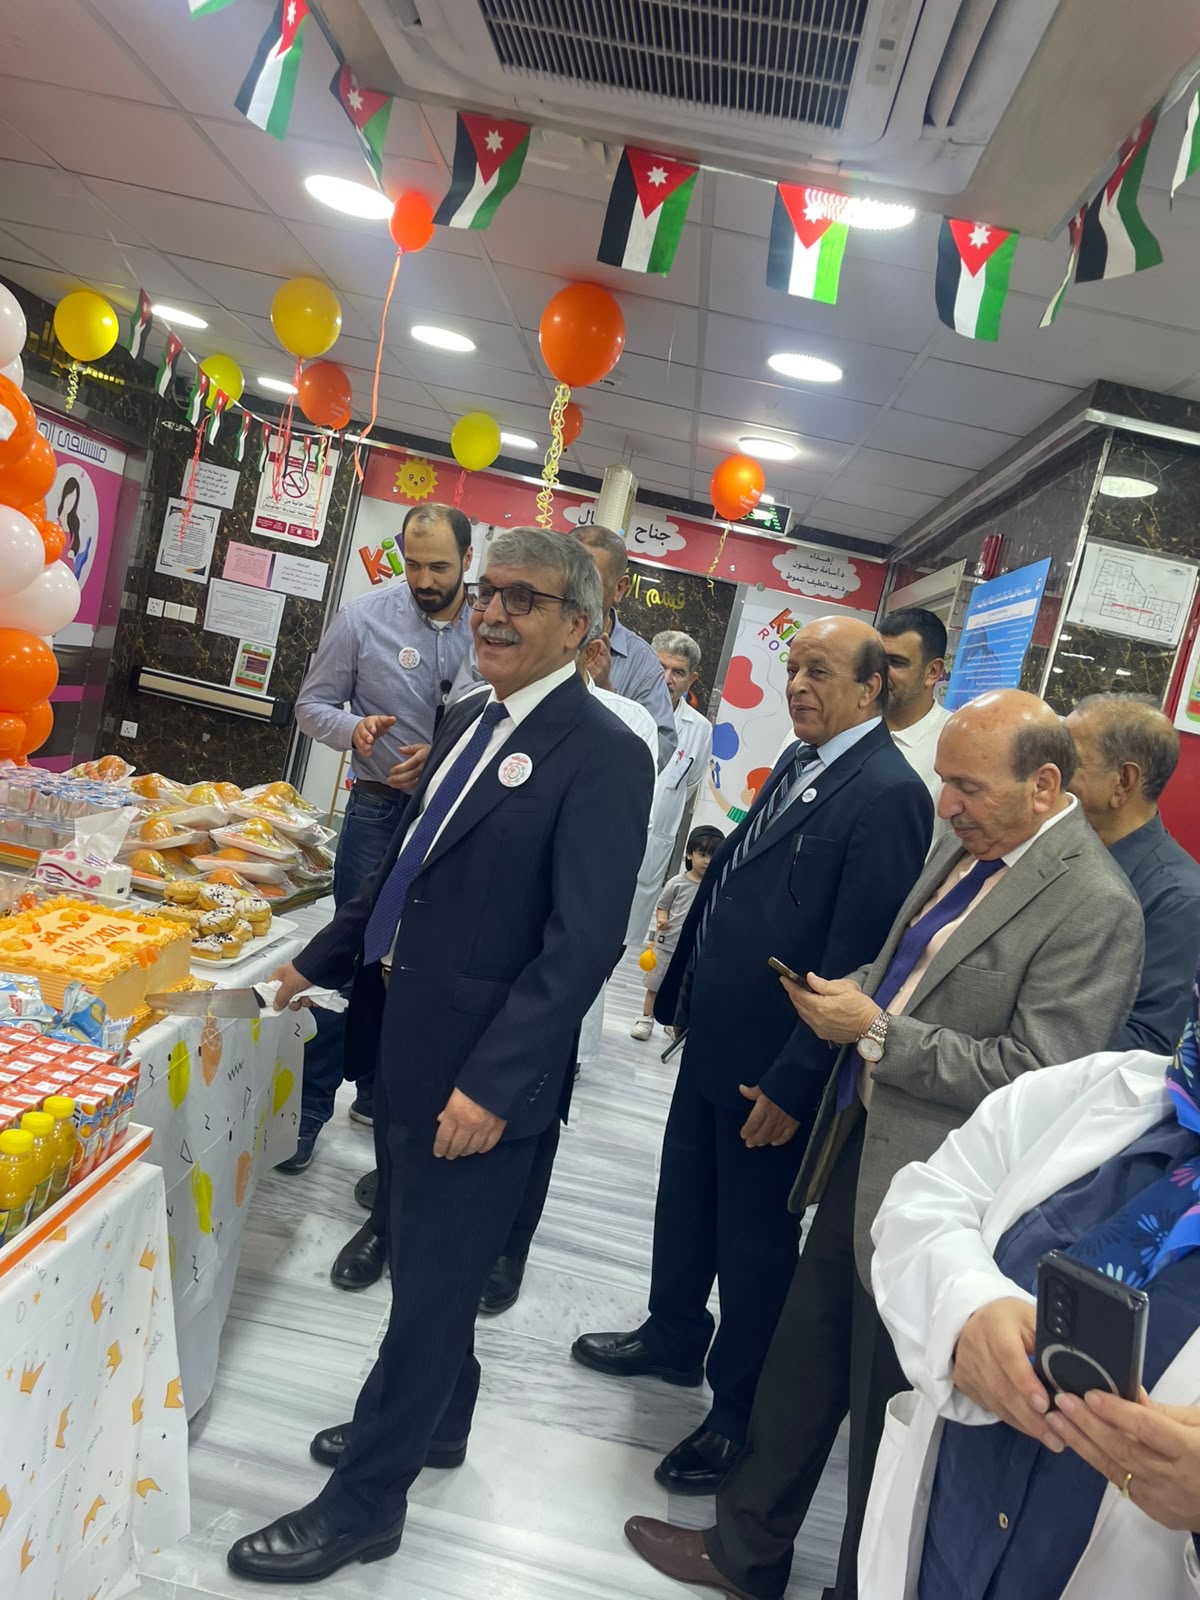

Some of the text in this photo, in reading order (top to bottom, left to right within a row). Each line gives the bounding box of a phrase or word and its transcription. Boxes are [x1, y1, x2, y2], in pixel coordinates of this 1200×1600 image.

[633, 523, 671, 546] جناح
[358, 533, 405, 586] Ki
[646, 585, 686, 610] قسم
[769, 608, 802, 645] Ki
